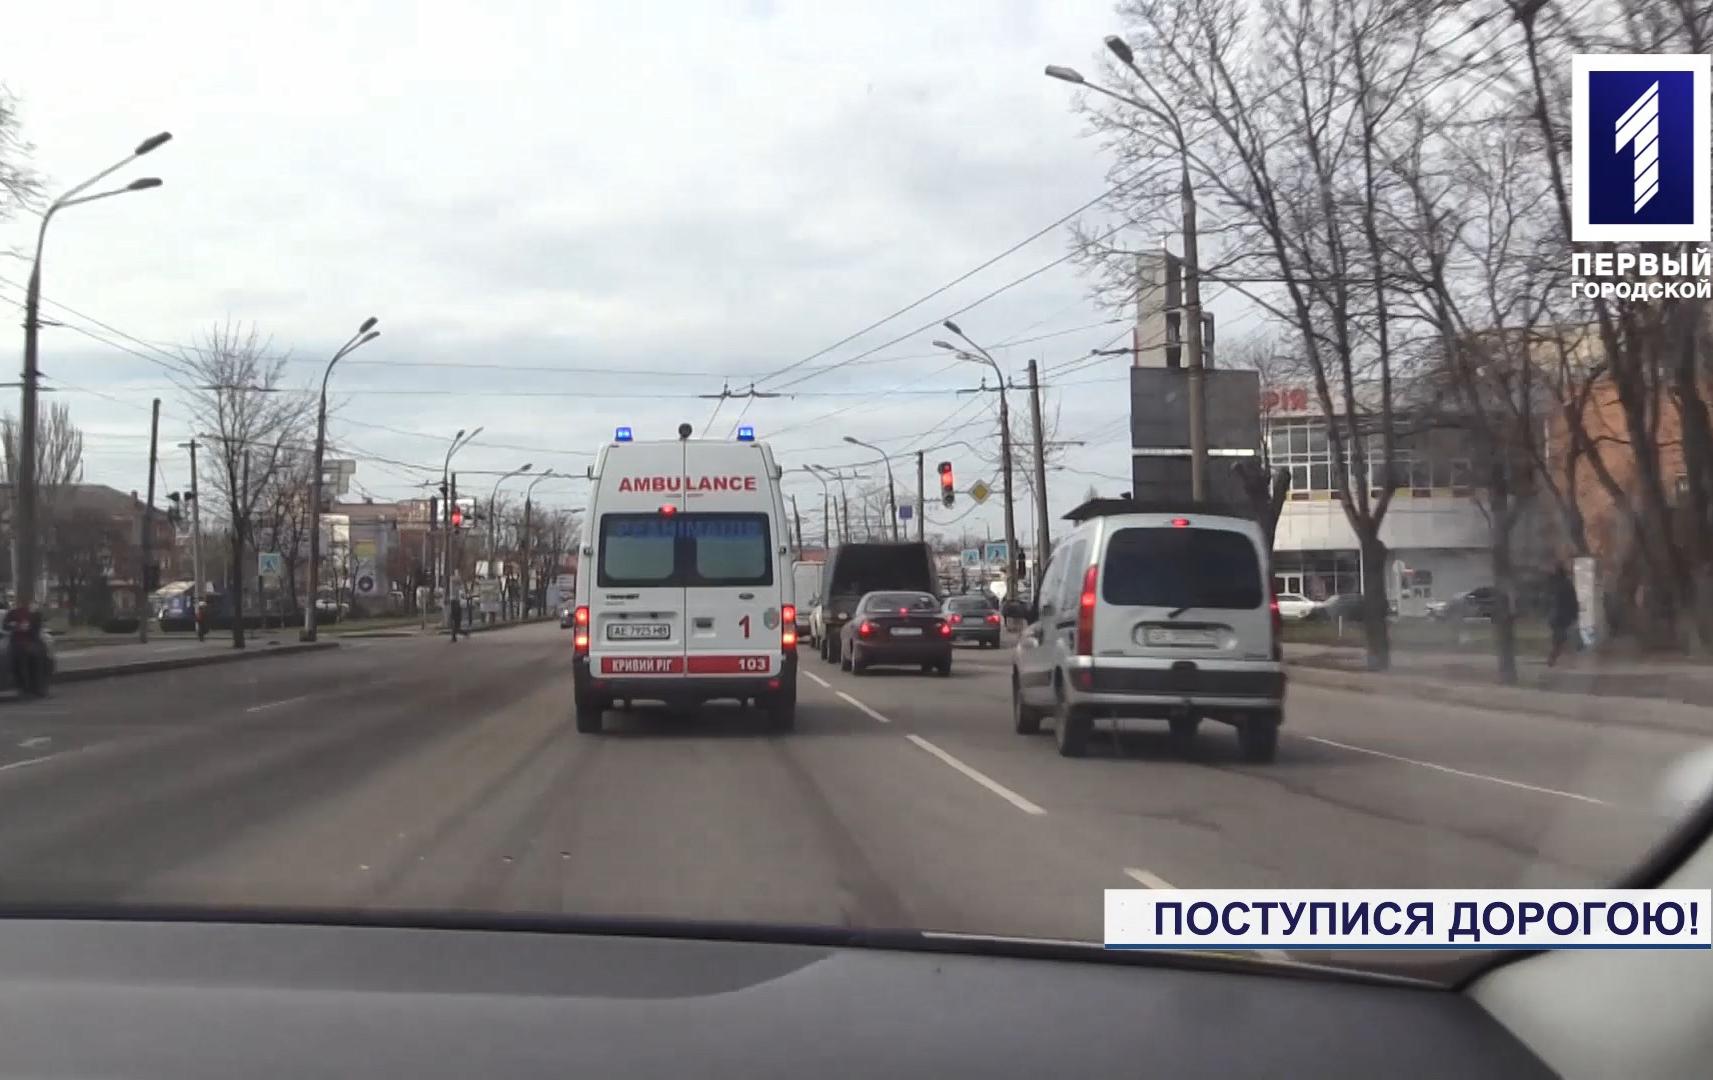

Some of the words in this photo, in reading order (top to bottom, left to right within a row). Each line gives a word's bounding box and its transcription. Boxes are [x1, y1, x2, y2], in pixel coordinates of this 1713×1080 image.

[618, 476, 757, 492] AMBULANCE
[739, 614, 750, 639] 1
[656, 658, 673, 673] РІГ
[739, 659, 767, 671] 103
